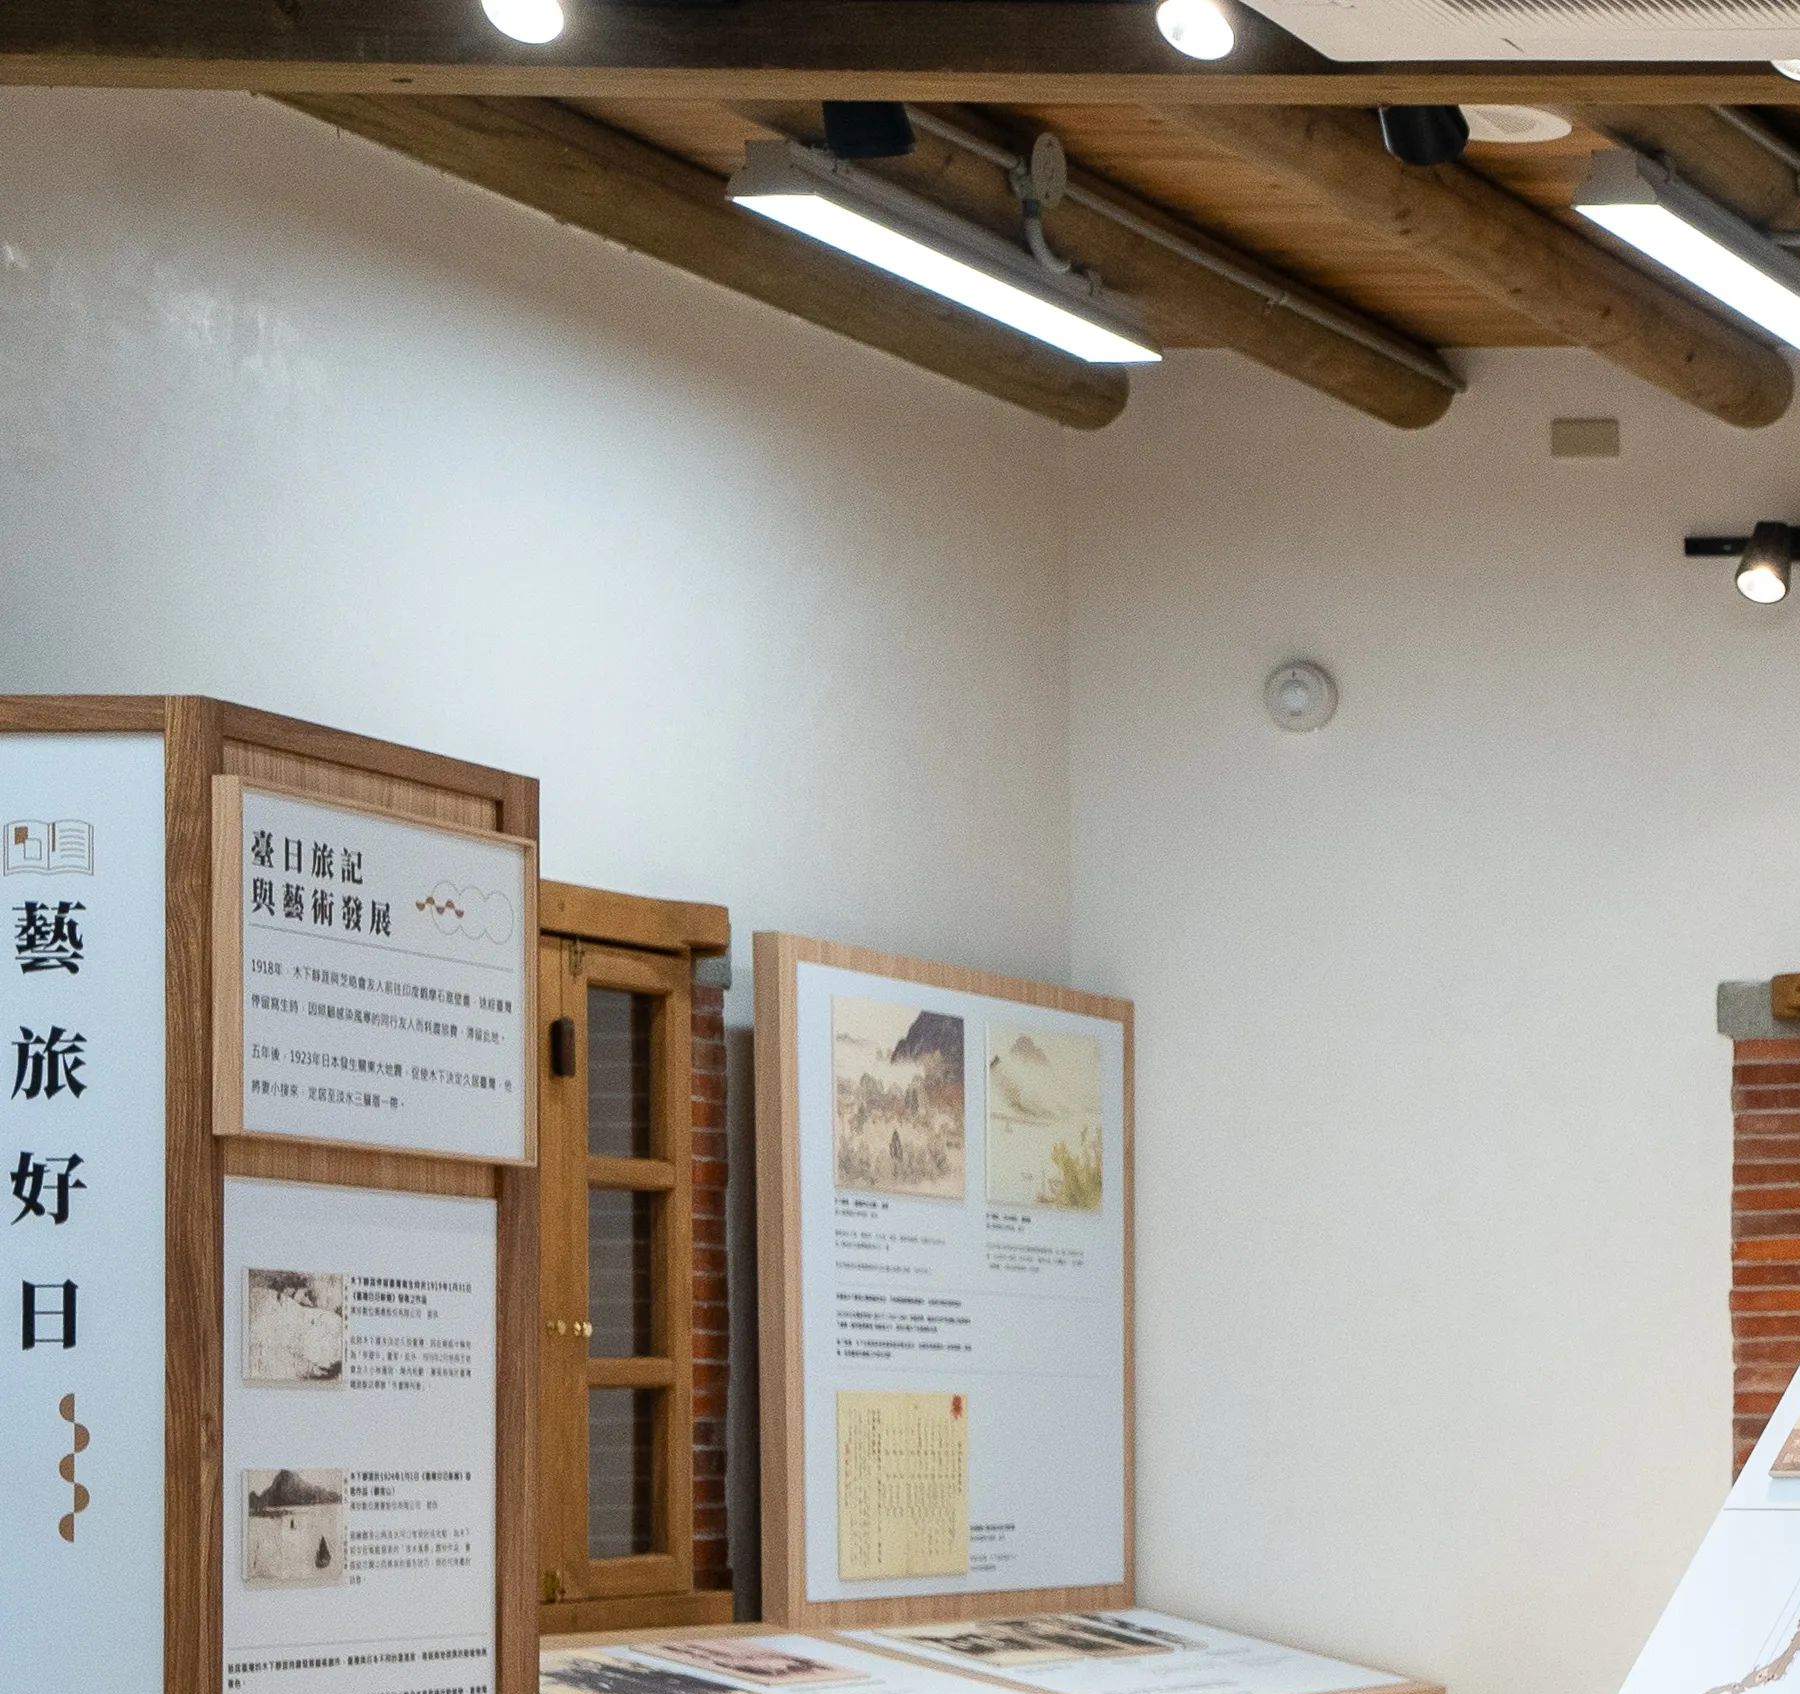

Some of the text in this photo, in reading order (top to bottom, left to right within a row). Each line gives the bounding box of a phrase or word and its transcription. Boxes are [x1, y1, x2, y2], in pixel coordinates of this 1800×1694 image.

[251, 829, 364, 885] 臺日旅記
[251, 877, 393, 938] 與藝術發展
[9, 900, 88, 1352] 藝旅好日
